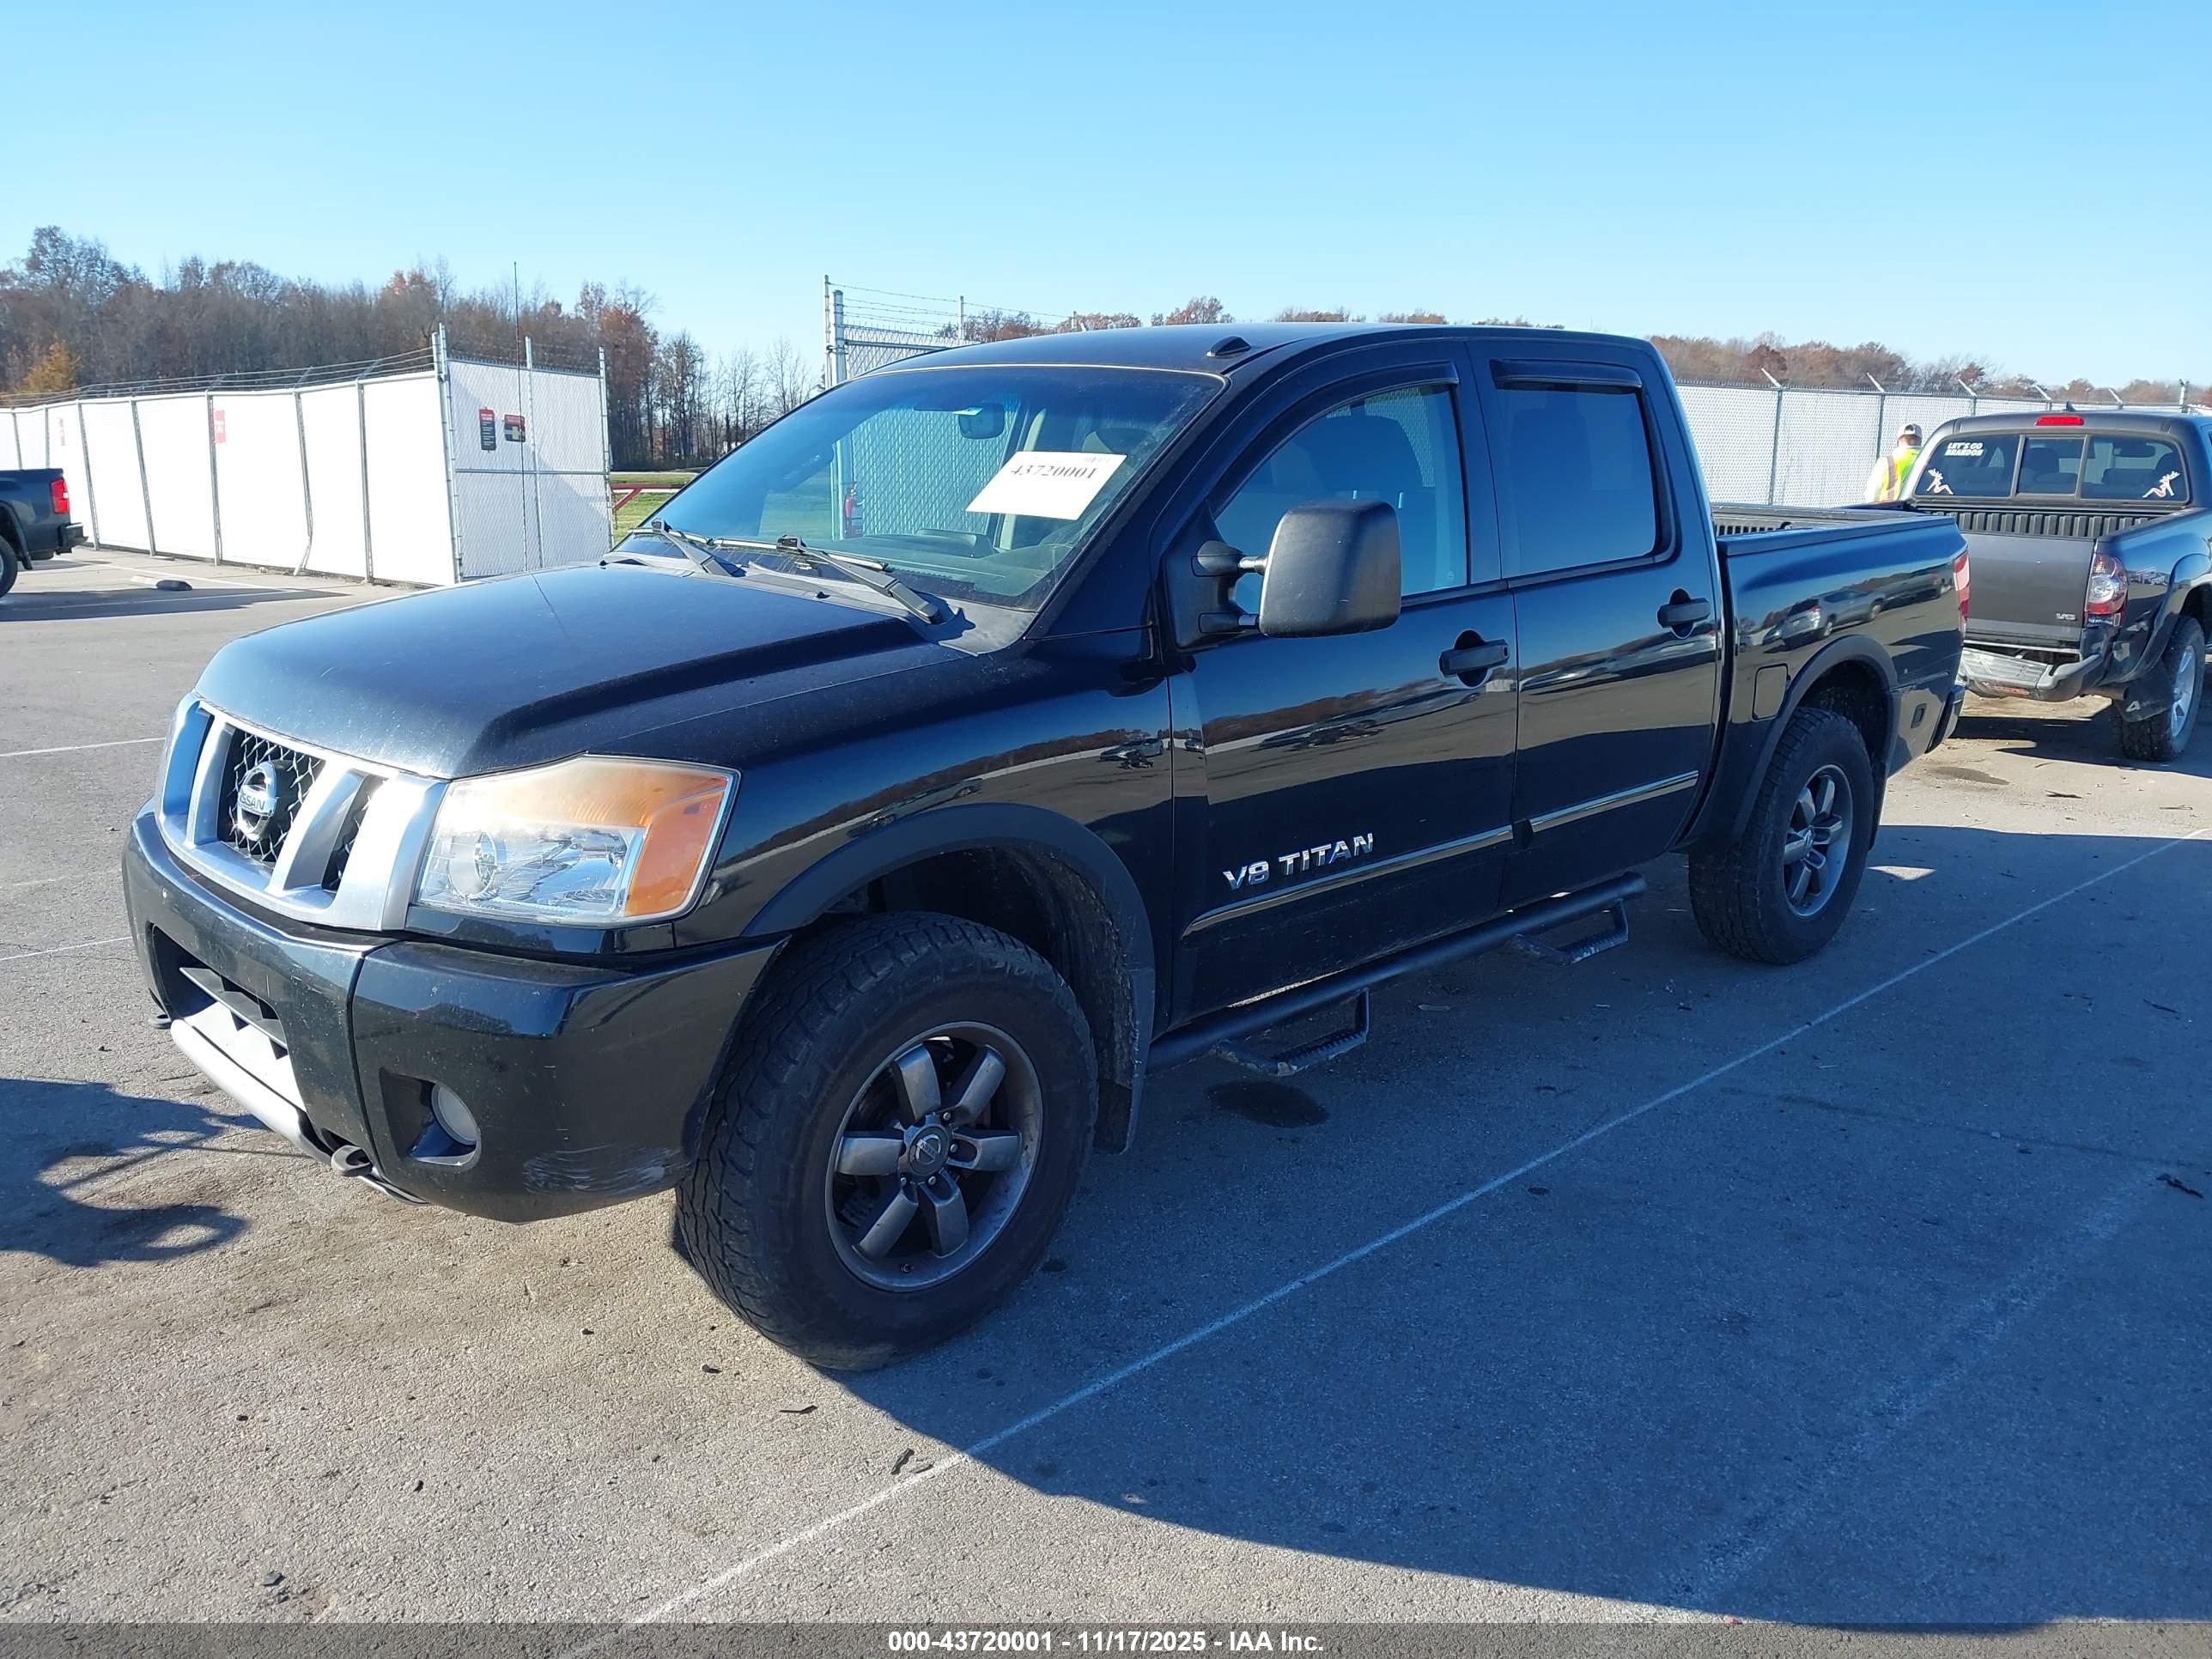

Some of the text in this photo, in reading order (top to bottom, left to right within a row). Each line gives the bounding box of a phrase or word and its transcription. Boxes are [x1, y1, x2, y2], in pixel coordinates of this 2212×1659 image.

[1011, 465, 1097, 478] 43720001
[1223, 833, 1373, 890] V8 TITAN
